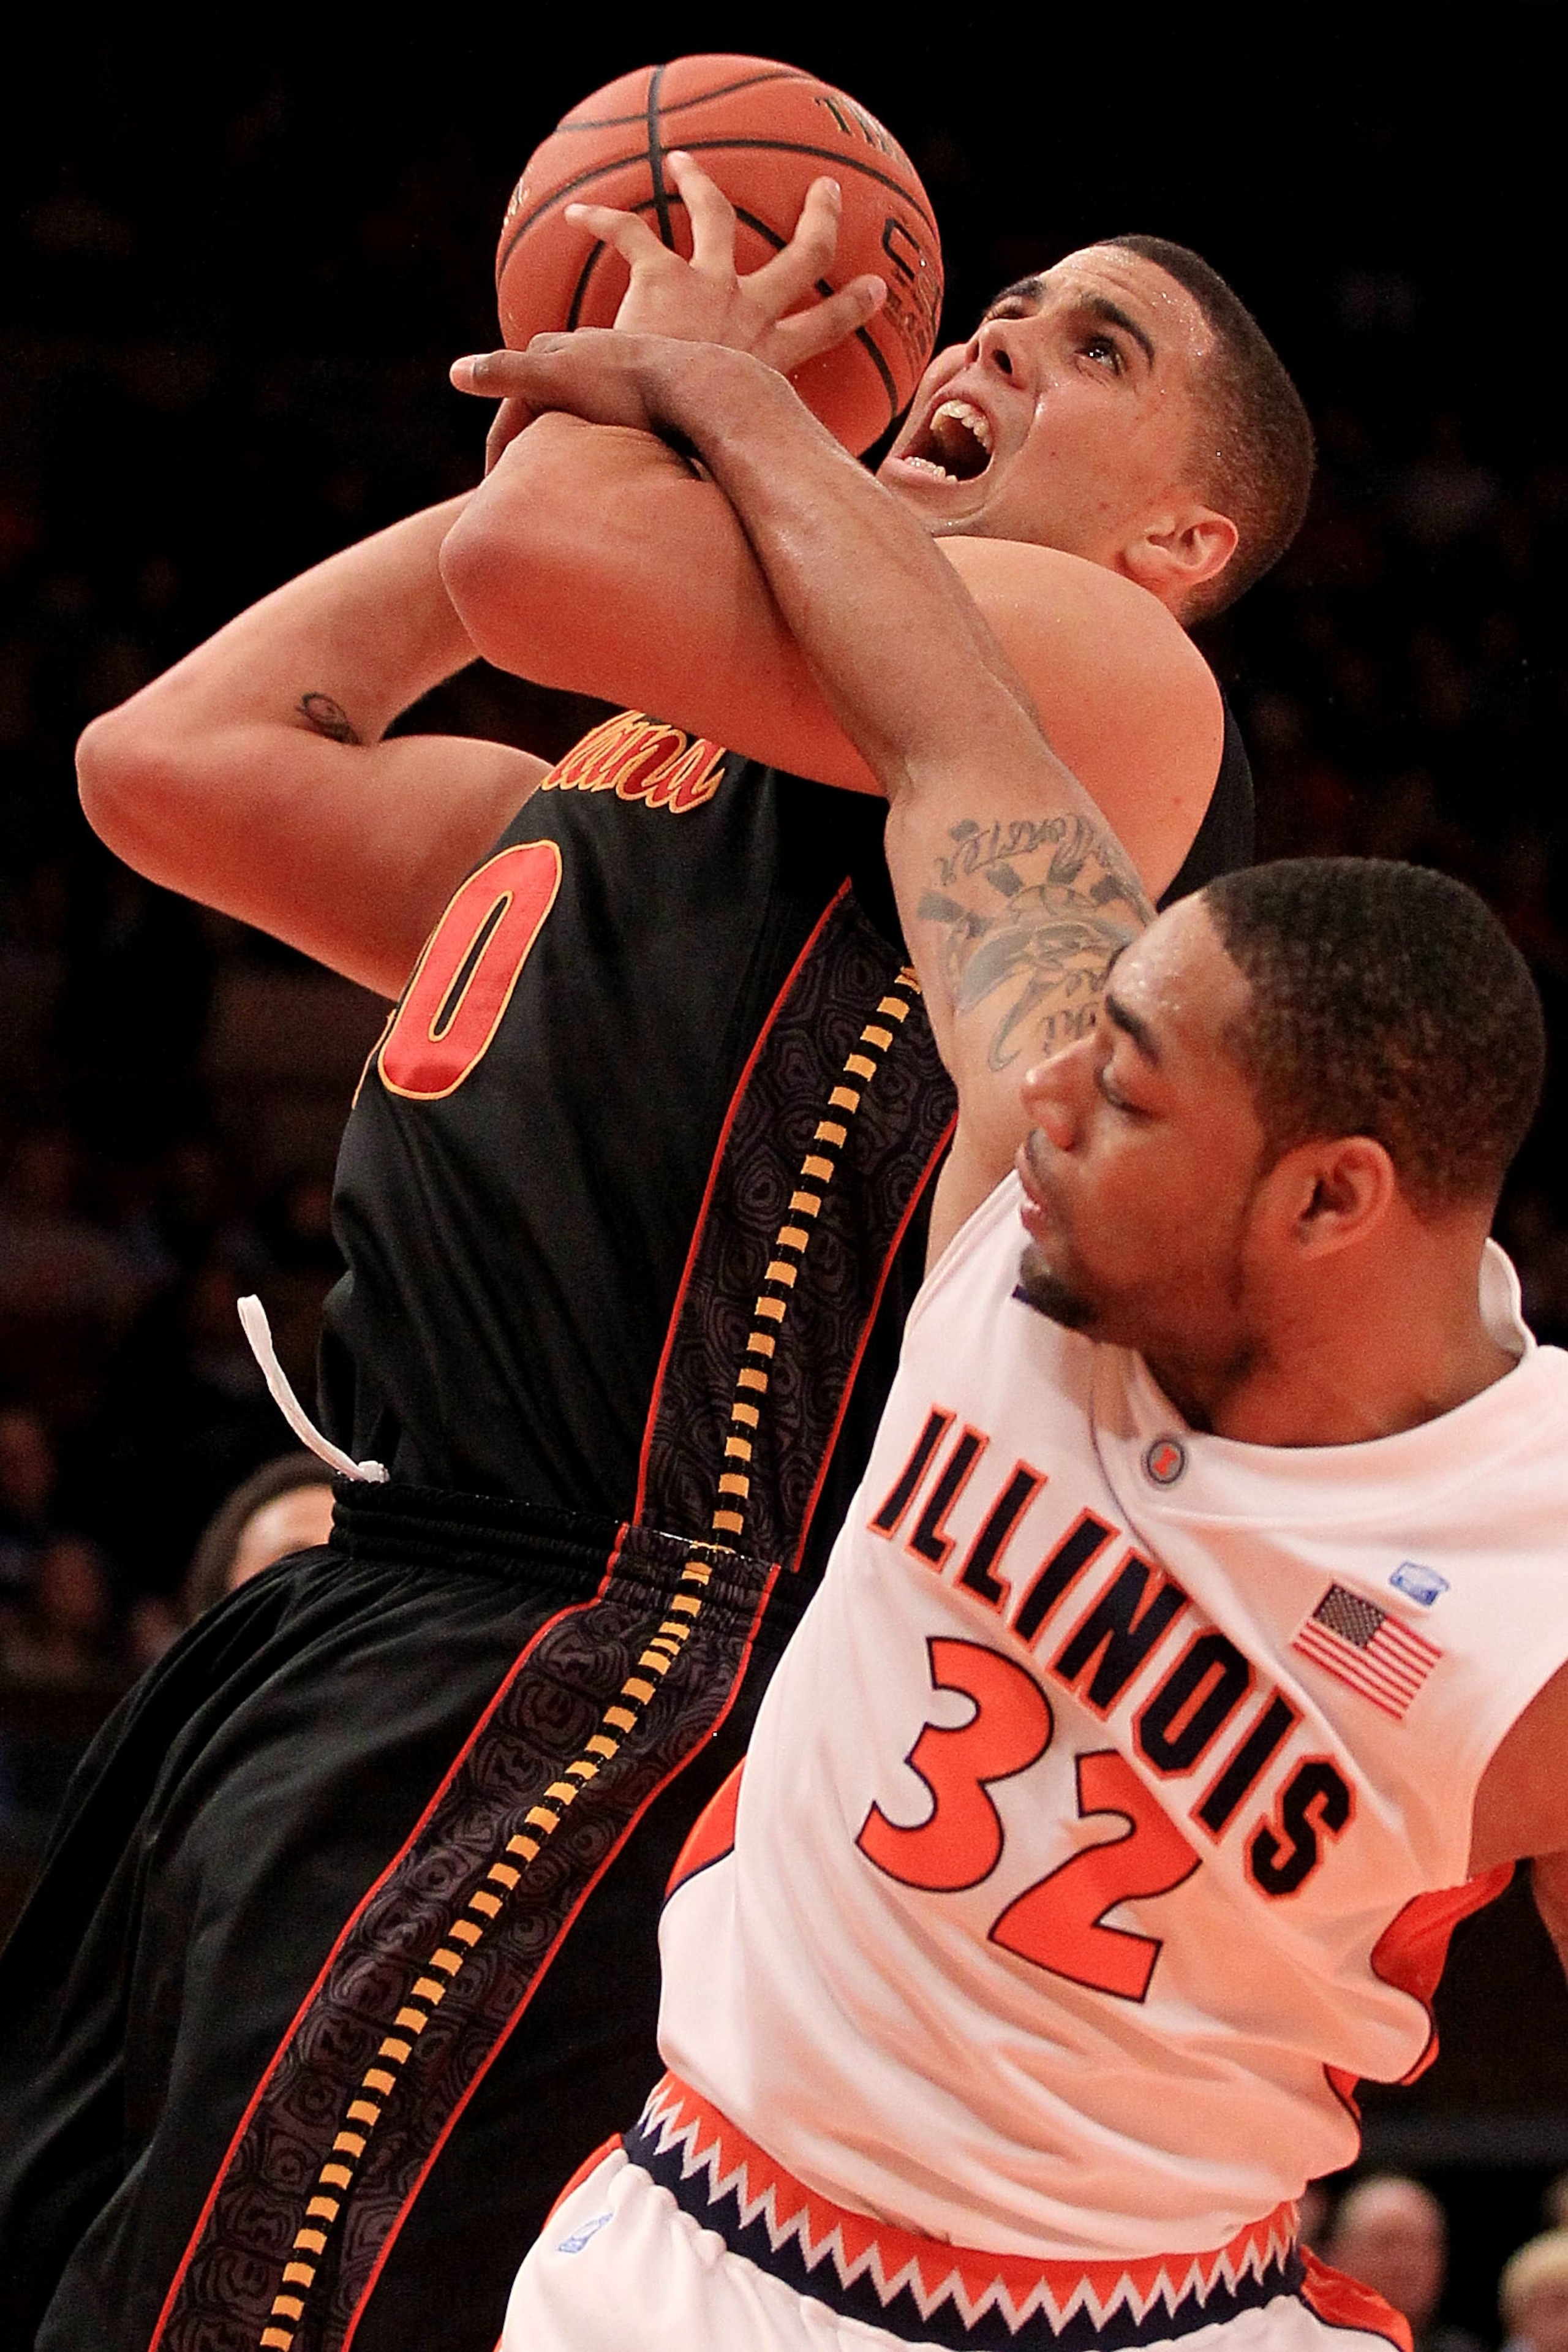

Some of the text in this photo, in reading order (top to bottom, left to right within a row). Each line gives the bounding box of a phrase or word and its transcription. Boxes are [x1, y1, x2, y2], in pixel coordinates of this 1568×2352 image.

[352, 839, 562, 1100] 0
[855, 1636, 1203, 2003] 32
[867, 1402, 1356, 1902] ILLINOIS
